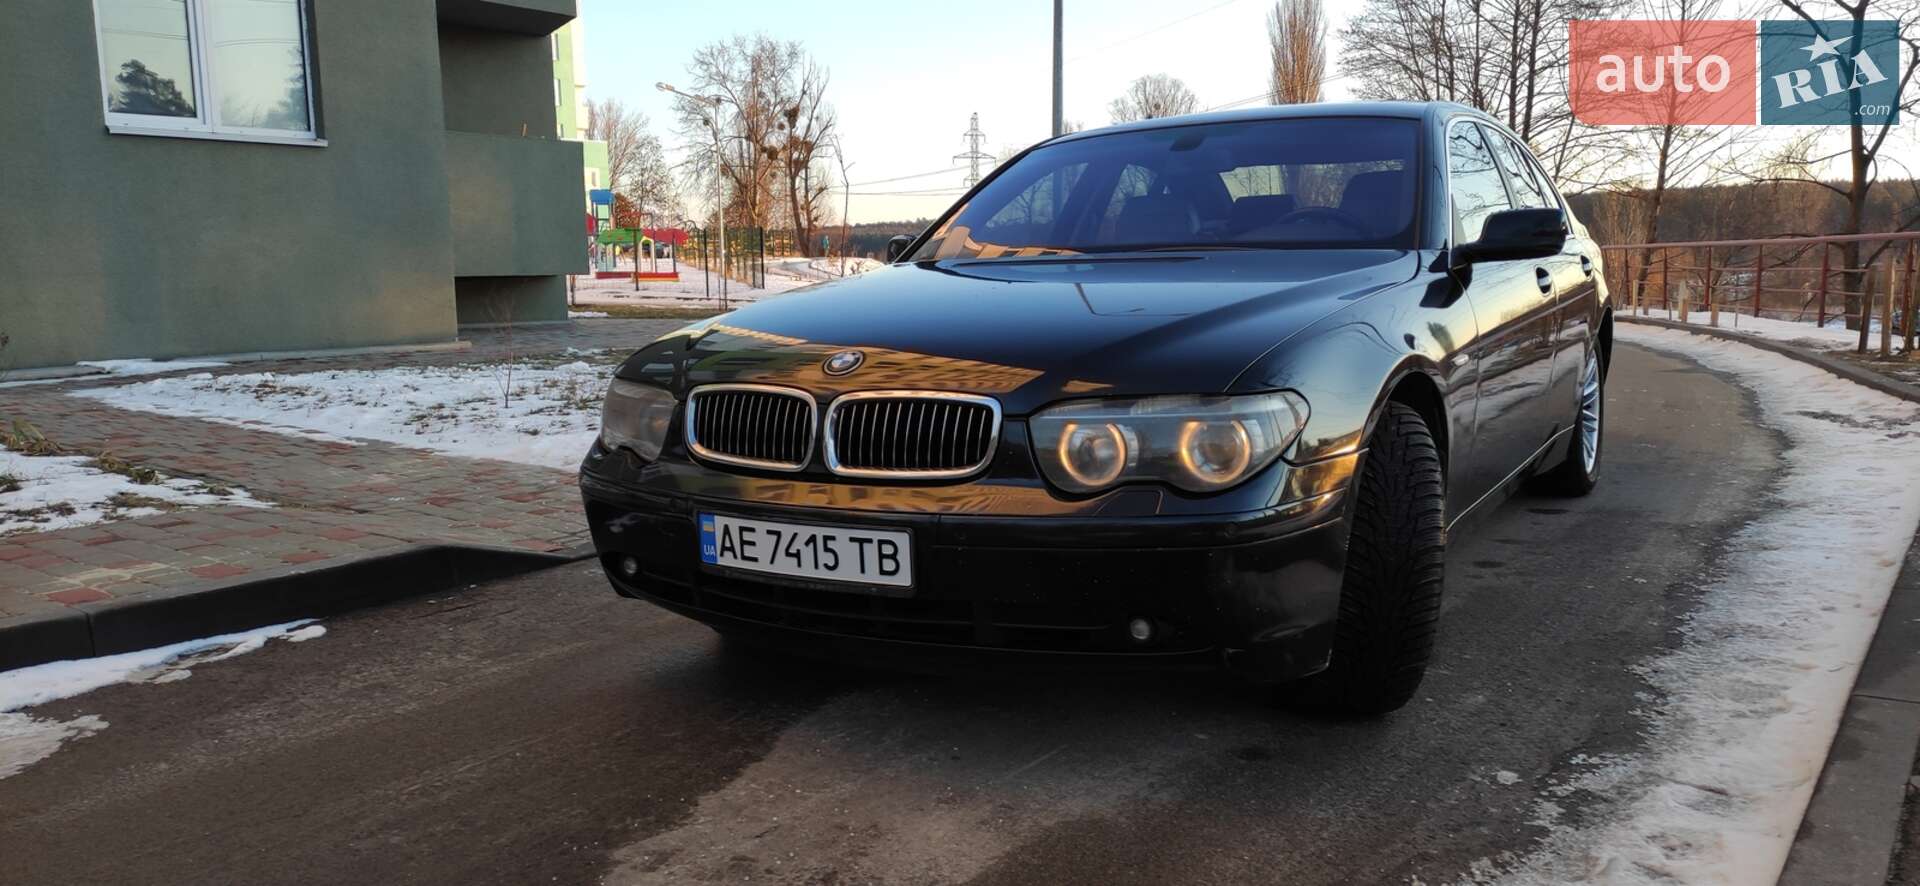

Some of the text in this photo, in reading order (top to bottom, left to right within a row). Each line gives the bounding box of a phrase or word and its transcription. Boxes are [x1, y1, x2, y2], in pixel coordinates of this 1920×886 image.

[703, 543, 716, 557] UA
[719, 524, 901, 577] AE 7415 TB
